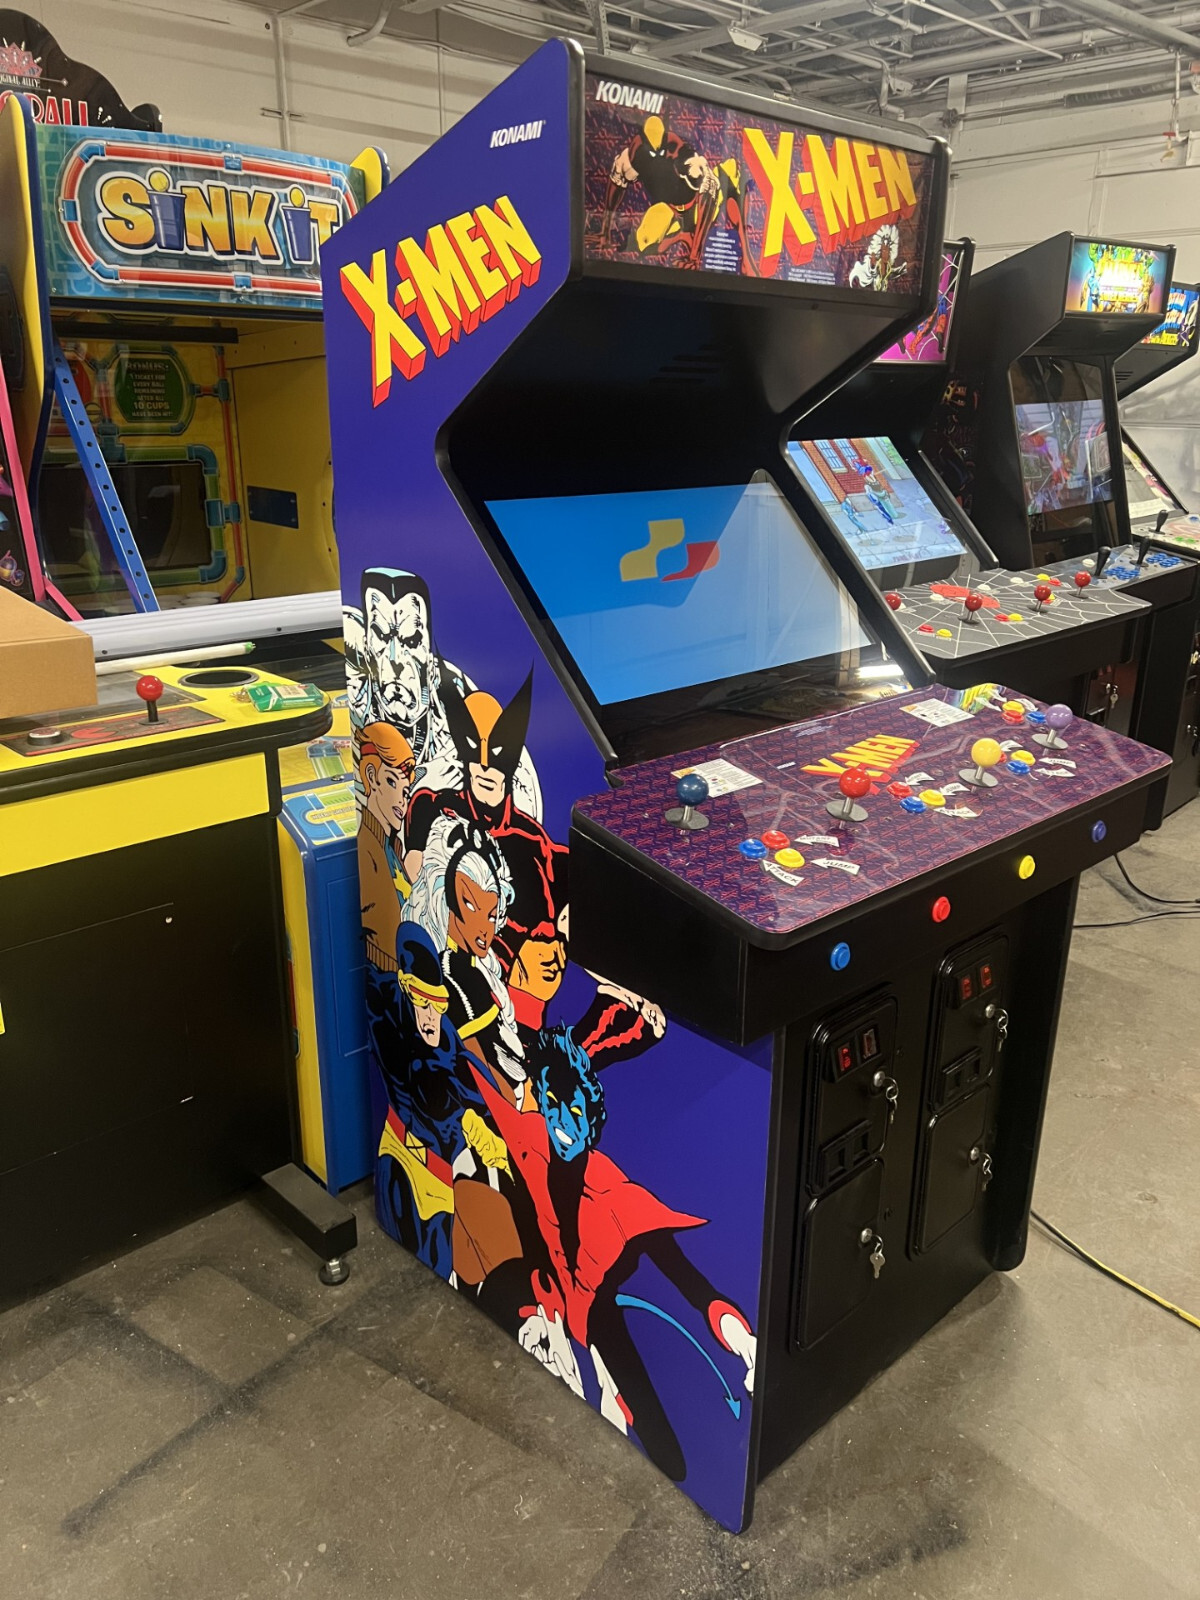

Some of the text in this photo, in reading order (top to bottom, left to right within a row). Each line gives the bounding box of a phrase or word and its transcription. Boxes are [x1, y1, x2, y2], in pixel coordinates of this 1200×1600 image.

[595, 80, 664, 114] KONAMI
[490, 120, 543, 149] KONAMI
[742, 127, 917, 275] X-MEN
[340, 195, 542, 408] X-MEN
[146, 401, 170, 410] CUPS
[800, 734, 920, 793] X-MEN
[765, 862, 798, 883] ATTACK
[822, 861, 855, 869] JUMP
